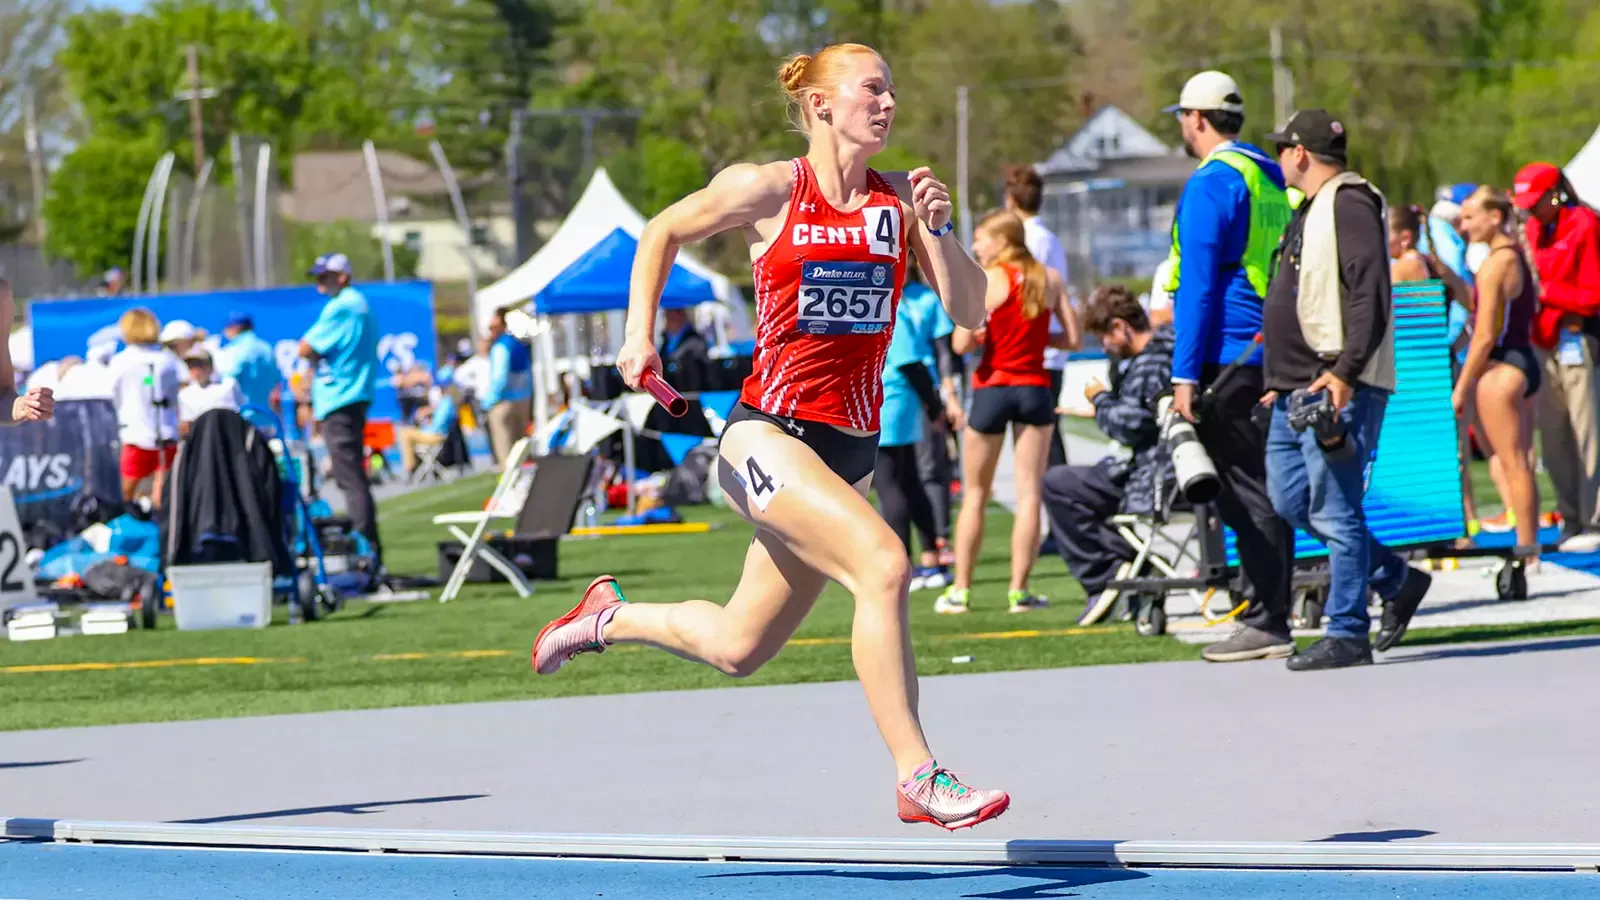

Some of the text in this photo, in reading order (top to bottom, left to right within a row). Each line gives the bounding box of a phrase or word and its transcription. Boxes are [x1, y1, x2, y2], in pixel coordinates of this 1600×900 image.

[875, 209, 896, 254] 4
[812, 266, 866, 279] Drake RELAYS
[802, 287, 890, 319] 2657
[0, 453, 72, 490] AYS
[746, 455, 776, 497] 4
[0, 531, 25, 592] 2
